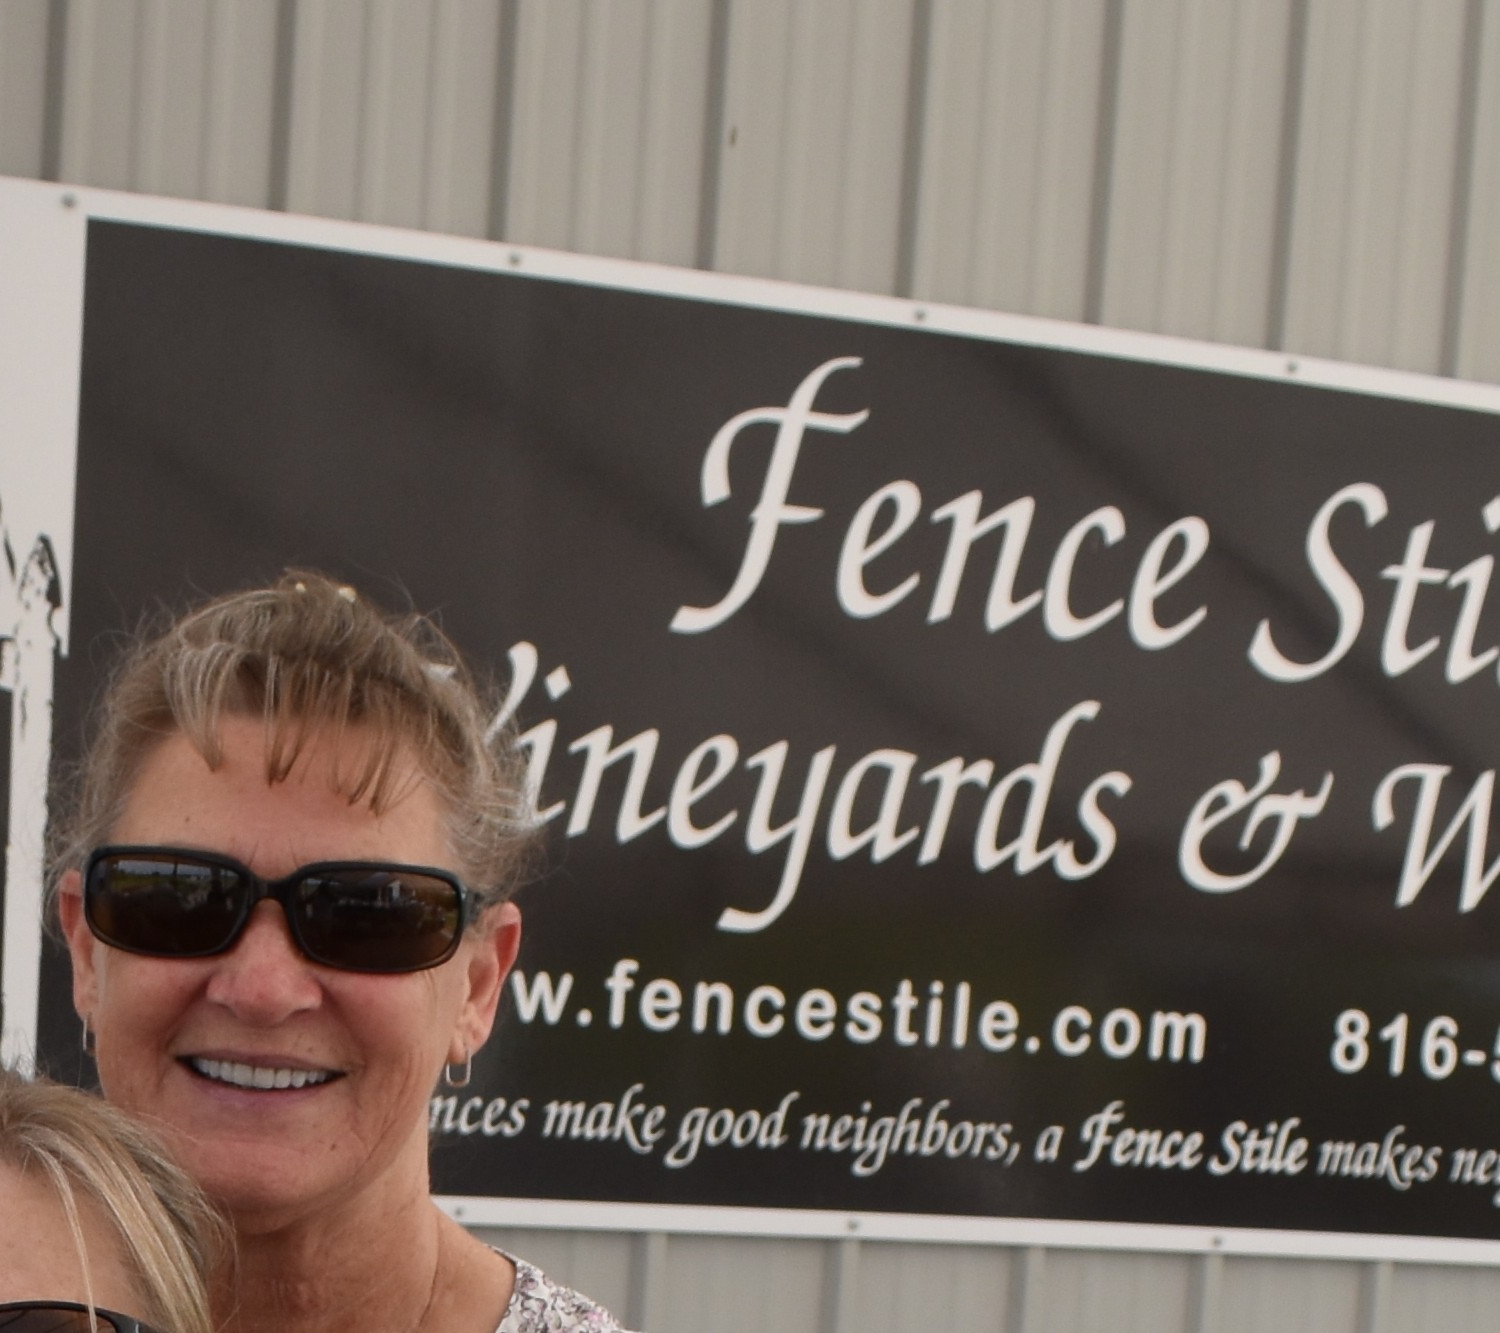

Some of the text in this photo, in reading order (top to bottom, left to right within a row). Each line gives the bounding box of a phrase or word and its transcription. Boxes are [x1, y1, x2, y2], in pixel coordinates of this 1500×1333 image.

[669, 356, 1211, 652] Fence
[1178, 750, 1335, 893] &
[510, 958, 1207, 1064] w.fencestile.com
[428, 1094, 531, 1138] nces
[542, 1083, 666, 1154] make
[664, 1091, 800, 1169] good
[801, 1097, 1021, 1177] neighbors,
[1034, 1125, 1065, 1162] a
[1074, 1100, 1204, 1171] Fence
[1208, 1117, 1309, 1175] Stile
[1317, 1125, 1443, 1188] makes
